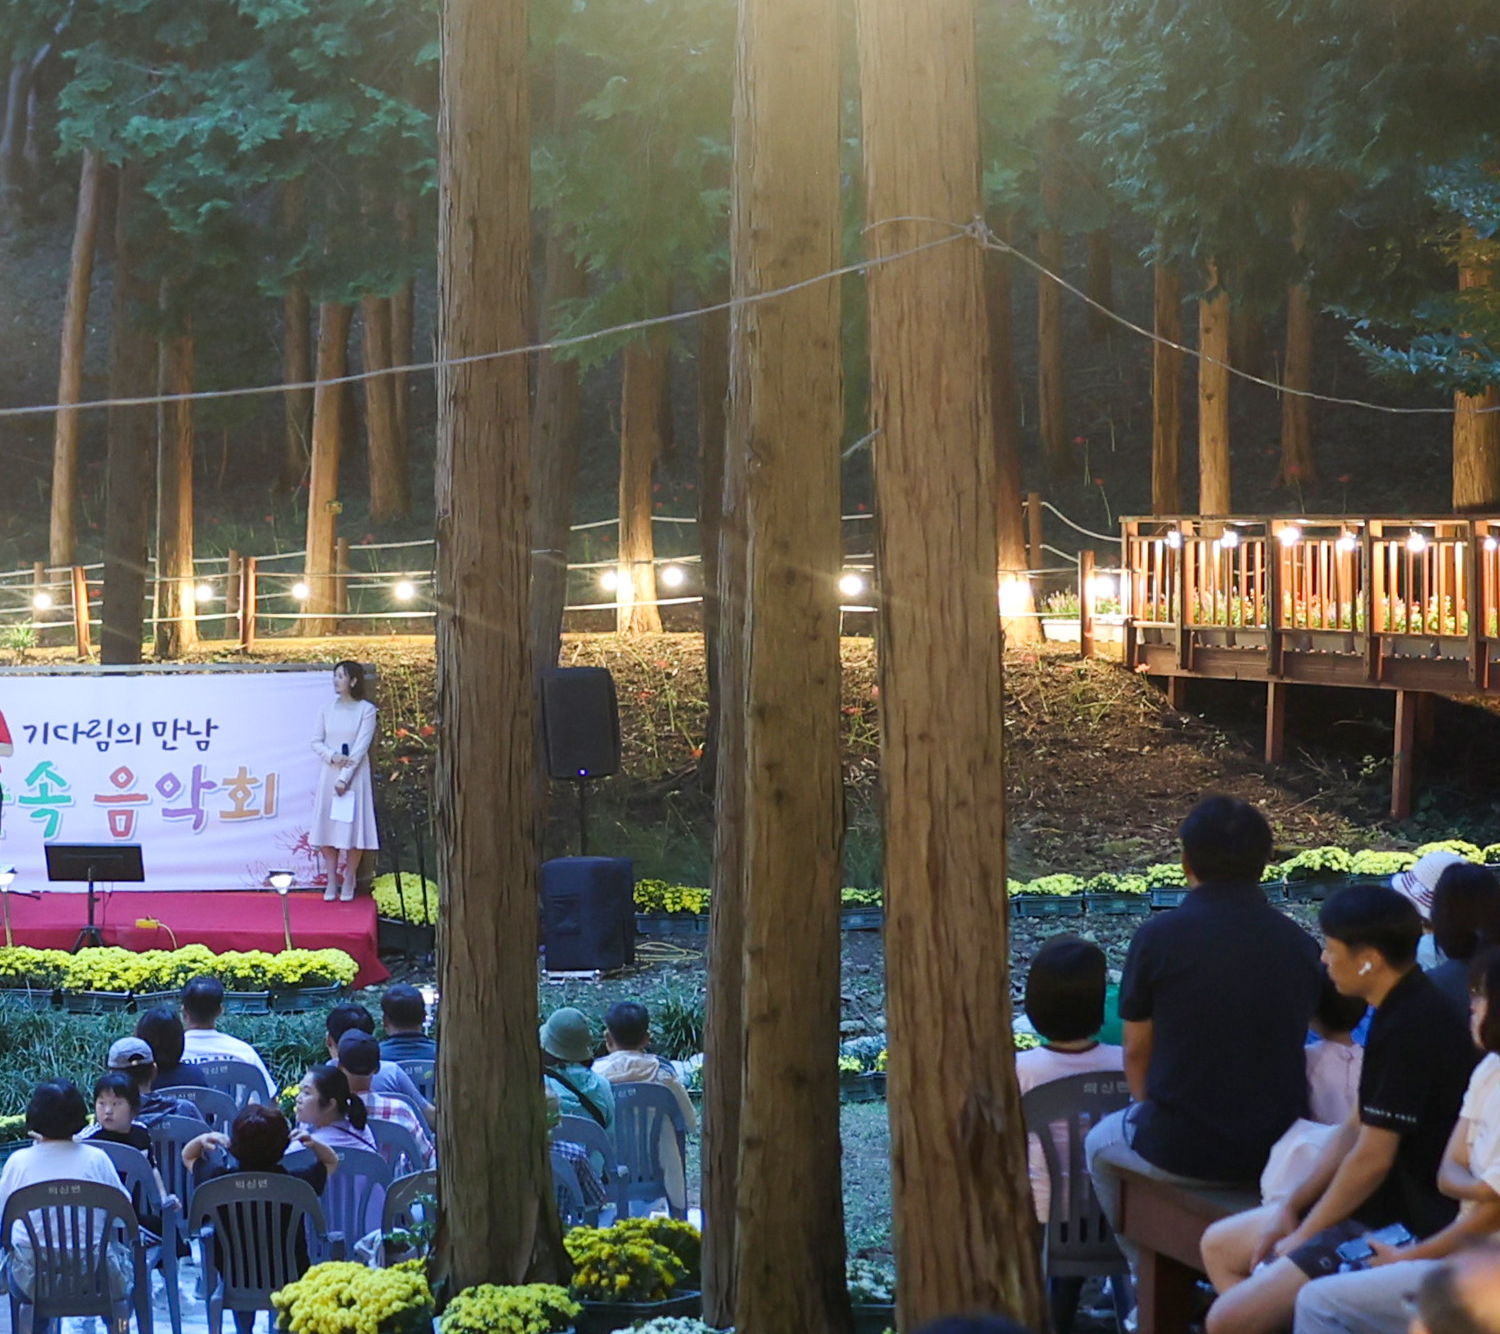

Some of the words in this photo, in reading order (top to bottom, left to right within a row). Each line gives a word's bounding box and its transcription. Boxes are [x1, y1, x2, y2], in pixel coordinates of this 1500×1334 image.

[22, 718, 142, 752] 기다림의
[151, 718, 219, 751] 만남
[0, 760, 73, 839] 속
[93, 764, 277, 838] 음악회
